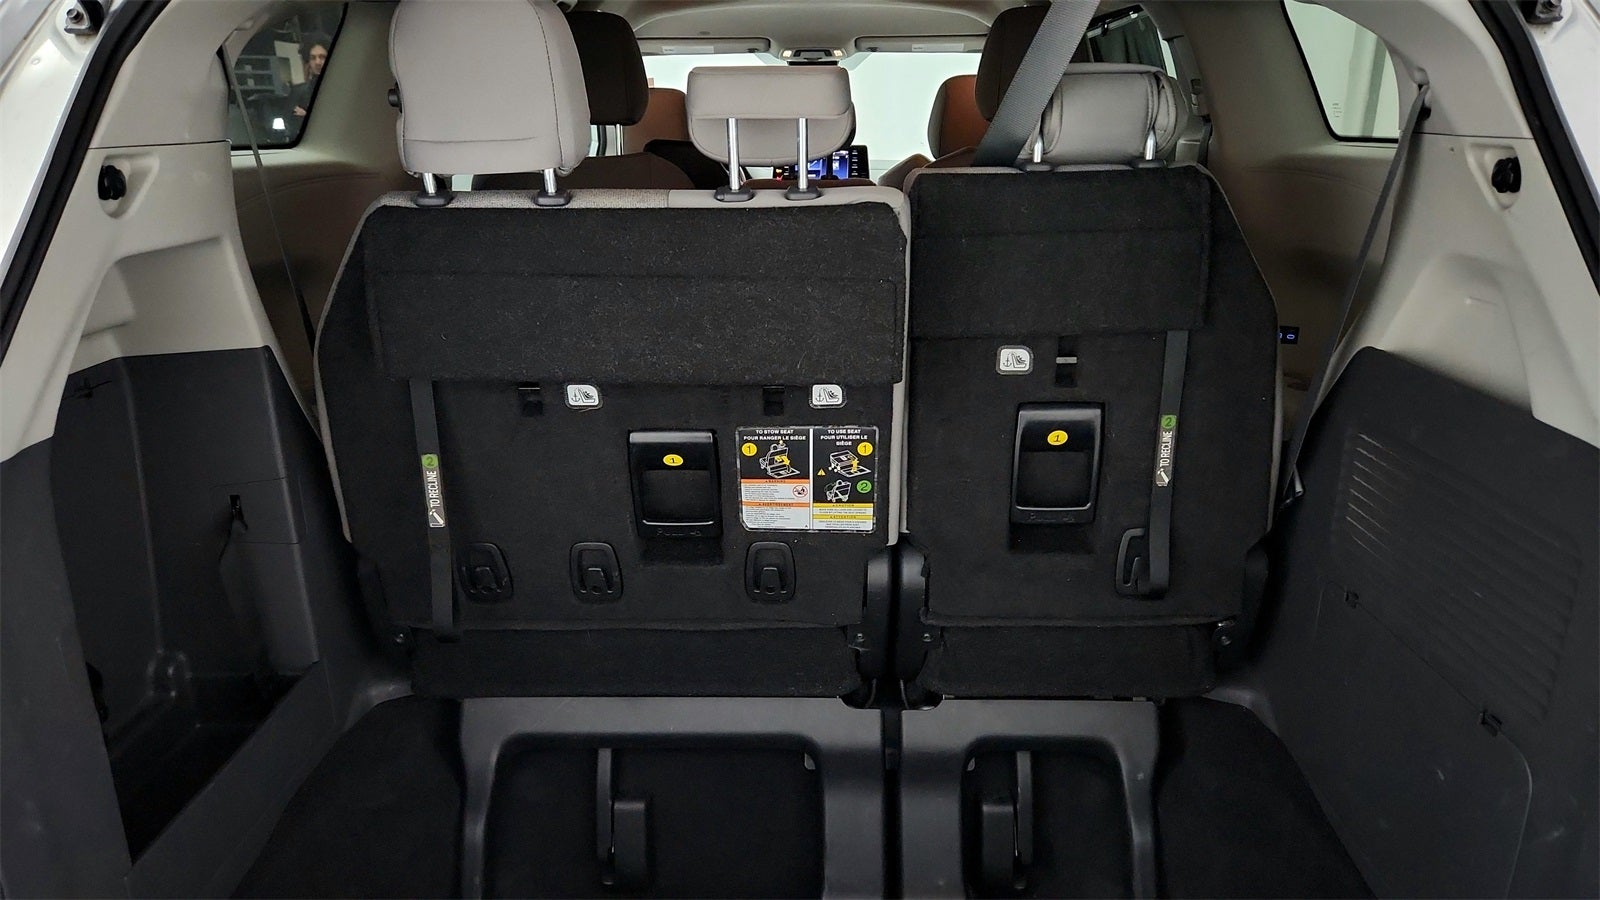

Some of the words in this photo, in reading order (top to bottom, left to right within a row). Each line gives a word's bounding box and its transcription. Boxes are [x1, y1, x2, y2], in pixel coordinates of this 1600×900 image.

[1161, 431, 1173, 458] RECLINE
[1160, 458, 1170, 467] TO
[426, 470, 439, 498] RECLINE
[429, 499, 441, 507] TO
